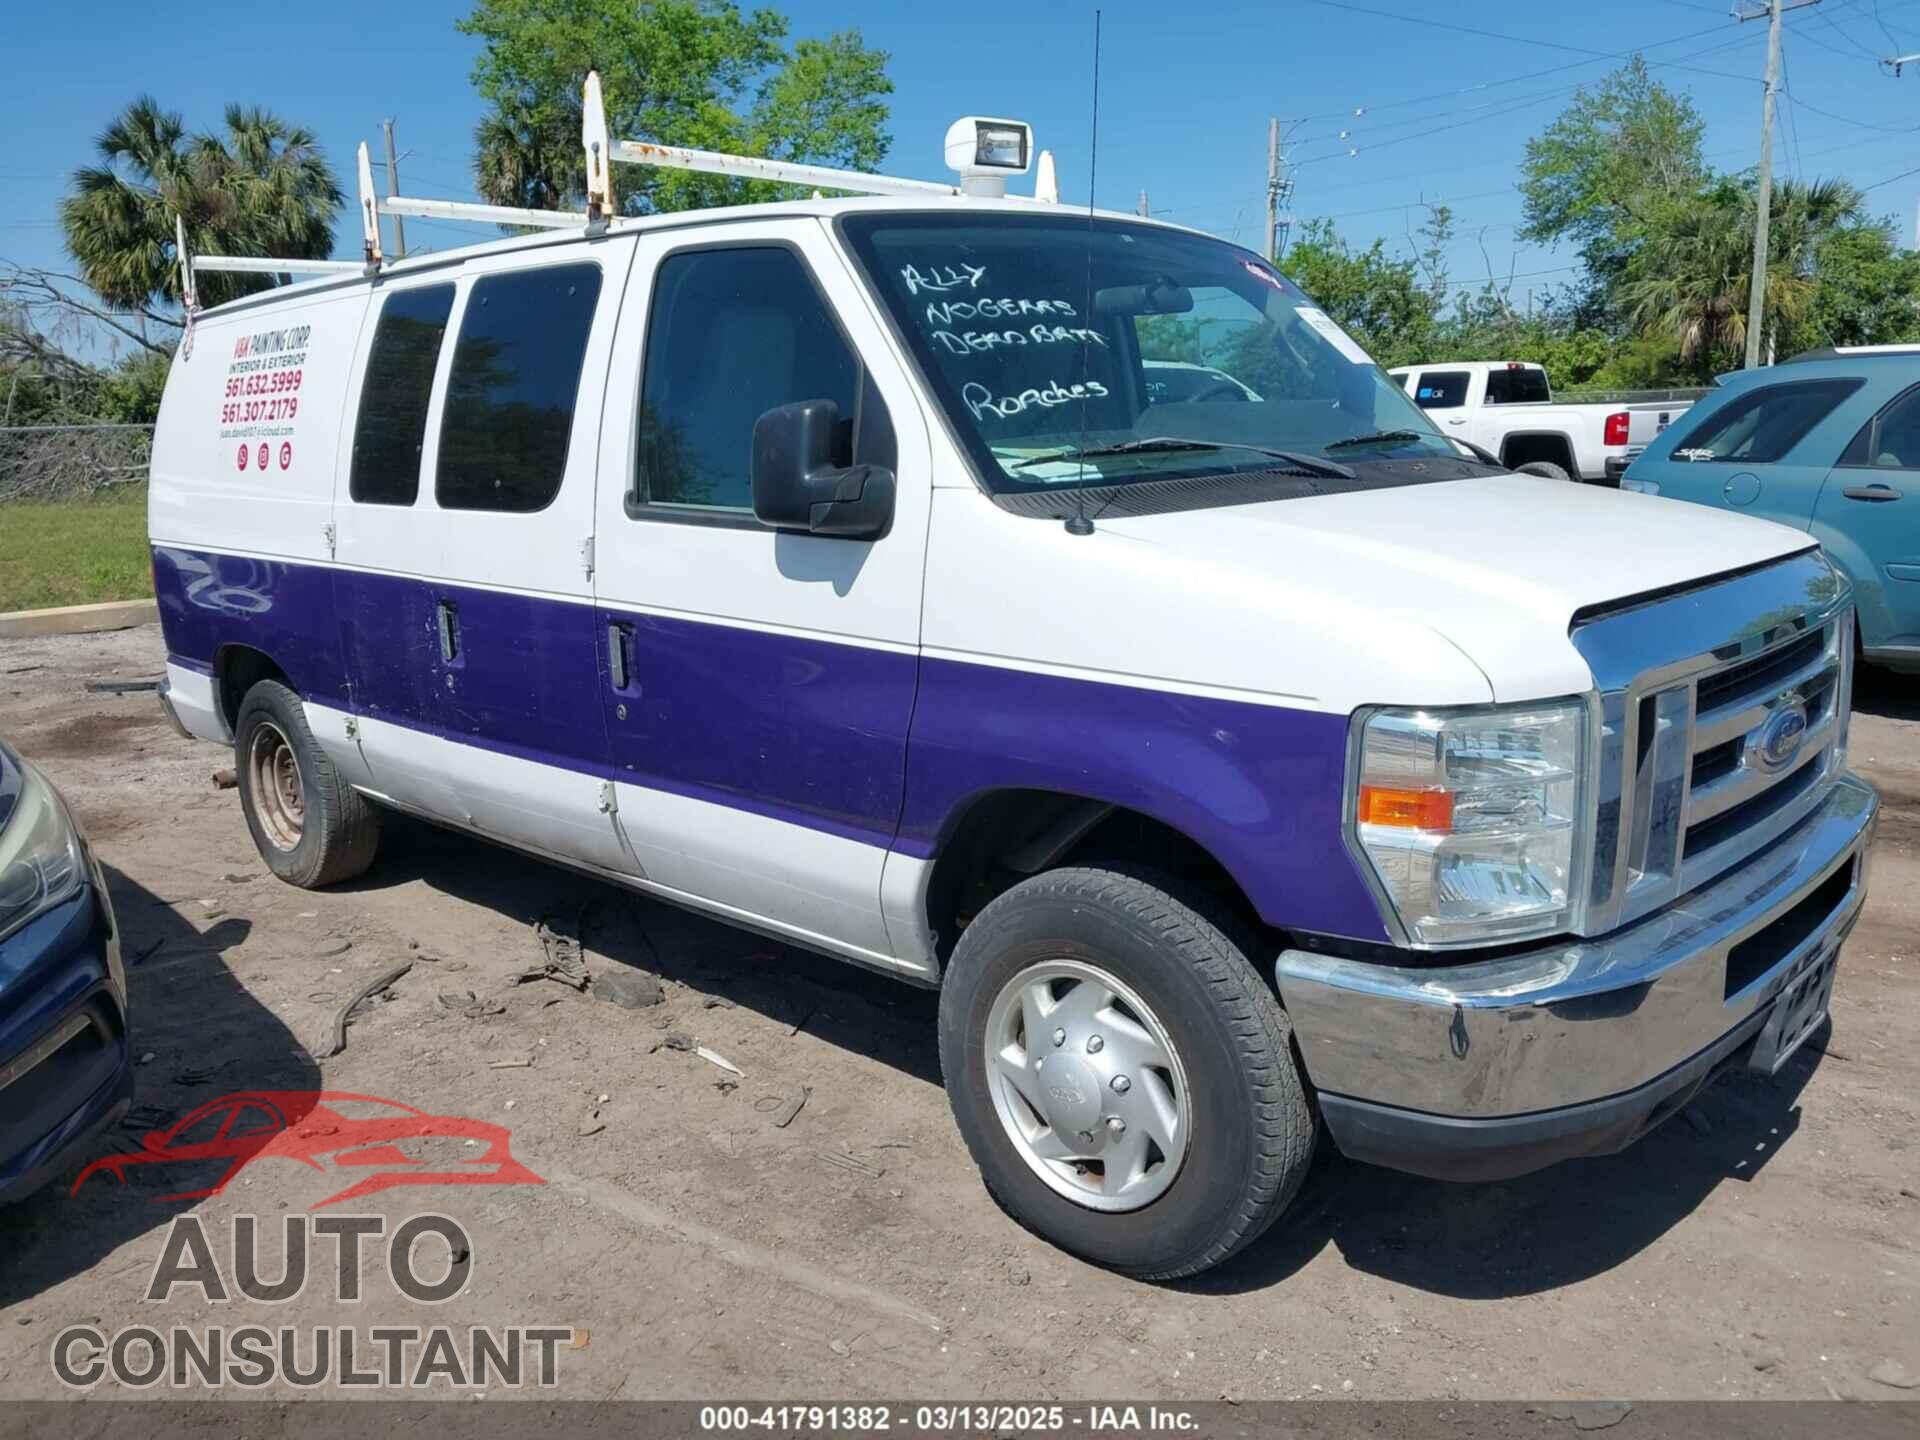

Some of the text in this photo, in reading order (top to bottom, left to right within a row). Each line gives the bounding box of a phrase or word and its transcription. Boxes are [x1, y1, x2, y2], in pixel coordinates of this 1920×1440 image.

[249, 328, 288, 356] PAINTING
[229, 360, 262, 375] INTERIOR
[267, 352, 307, 369] EXTERIOR
[225, 370, 303, 398] 561.632.5999
[222, 397, 298, 424] 561.307.2179
